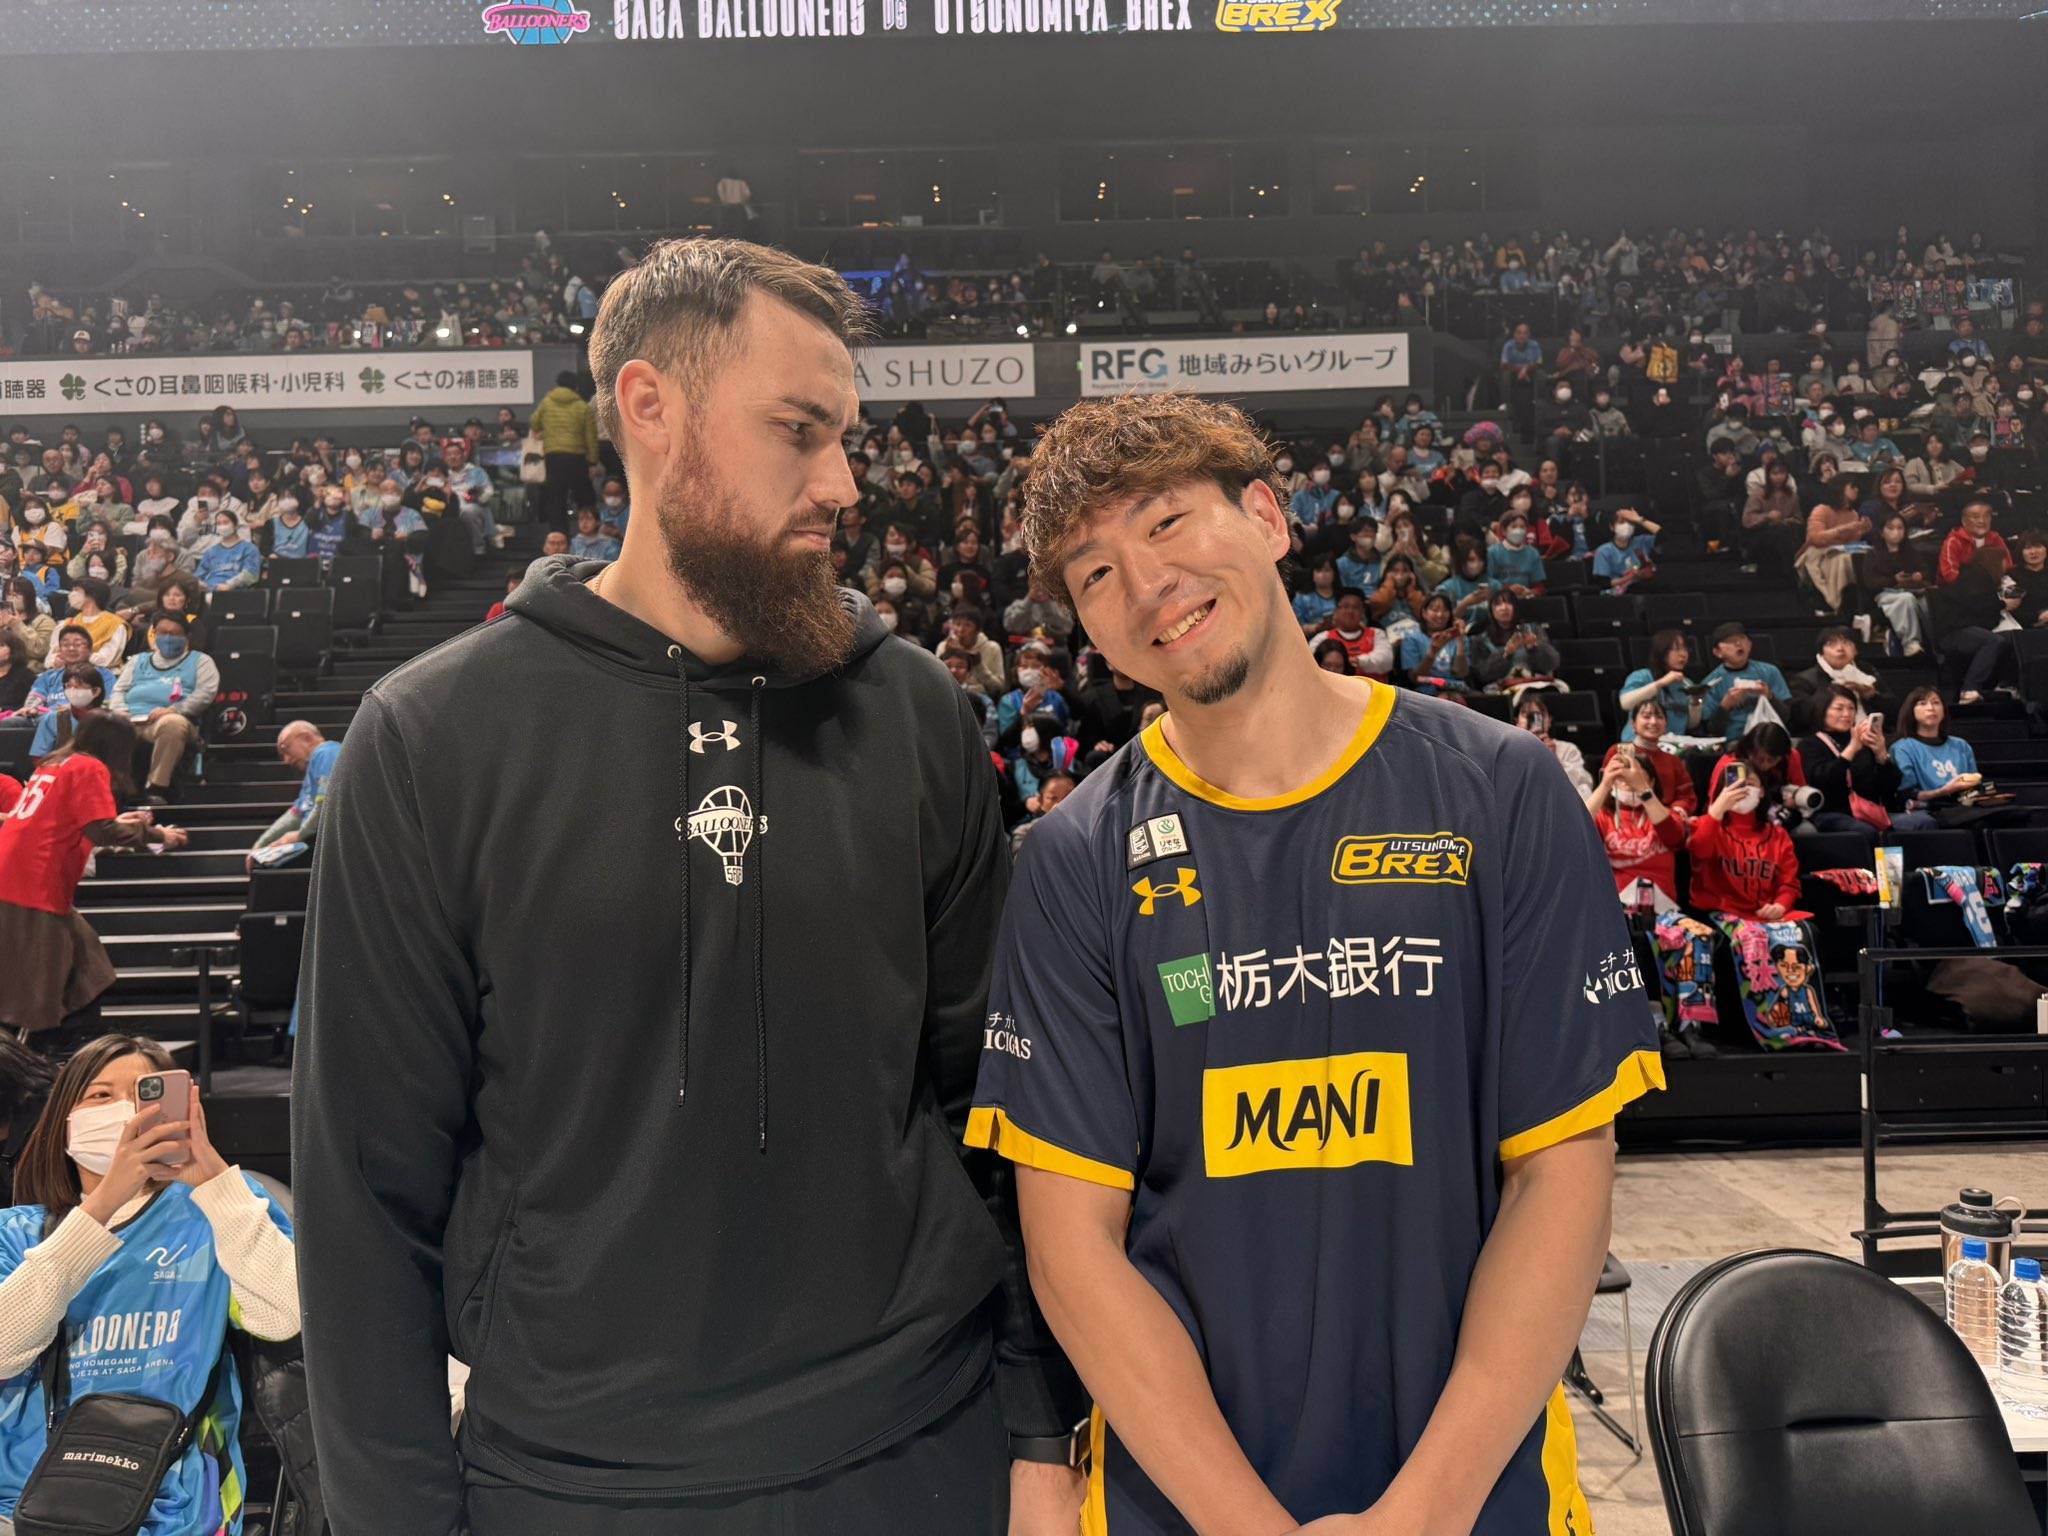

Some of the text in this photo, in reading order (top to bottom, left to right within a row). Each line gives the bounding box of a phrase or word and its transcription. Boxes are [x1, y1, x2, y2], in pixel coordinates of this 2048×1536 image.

[488, 13, 588, 31] BALLOONERS
[698, 0, 865, 38] BALLOONERS
[1126, 0, 1192, 31] BREX
[1222, 0, 1330, 26] BREX
[885, 357, 1023, 388] SHUZO
[1091, 348, 1168, 380] RFG
[1178, 346, 1398, 377] 地域みらいグループ
[0, 379, 46, 399] 聴器
[394, 368, 519, 391] くさの補聴器
[1339, 842, 1465, 877] BREX
[1216, 936, 1443, 1011] 栃木銀行
[1224, 1069, 1380, 1151] MANI
[62, 1451, 140, 1471] marimekko
